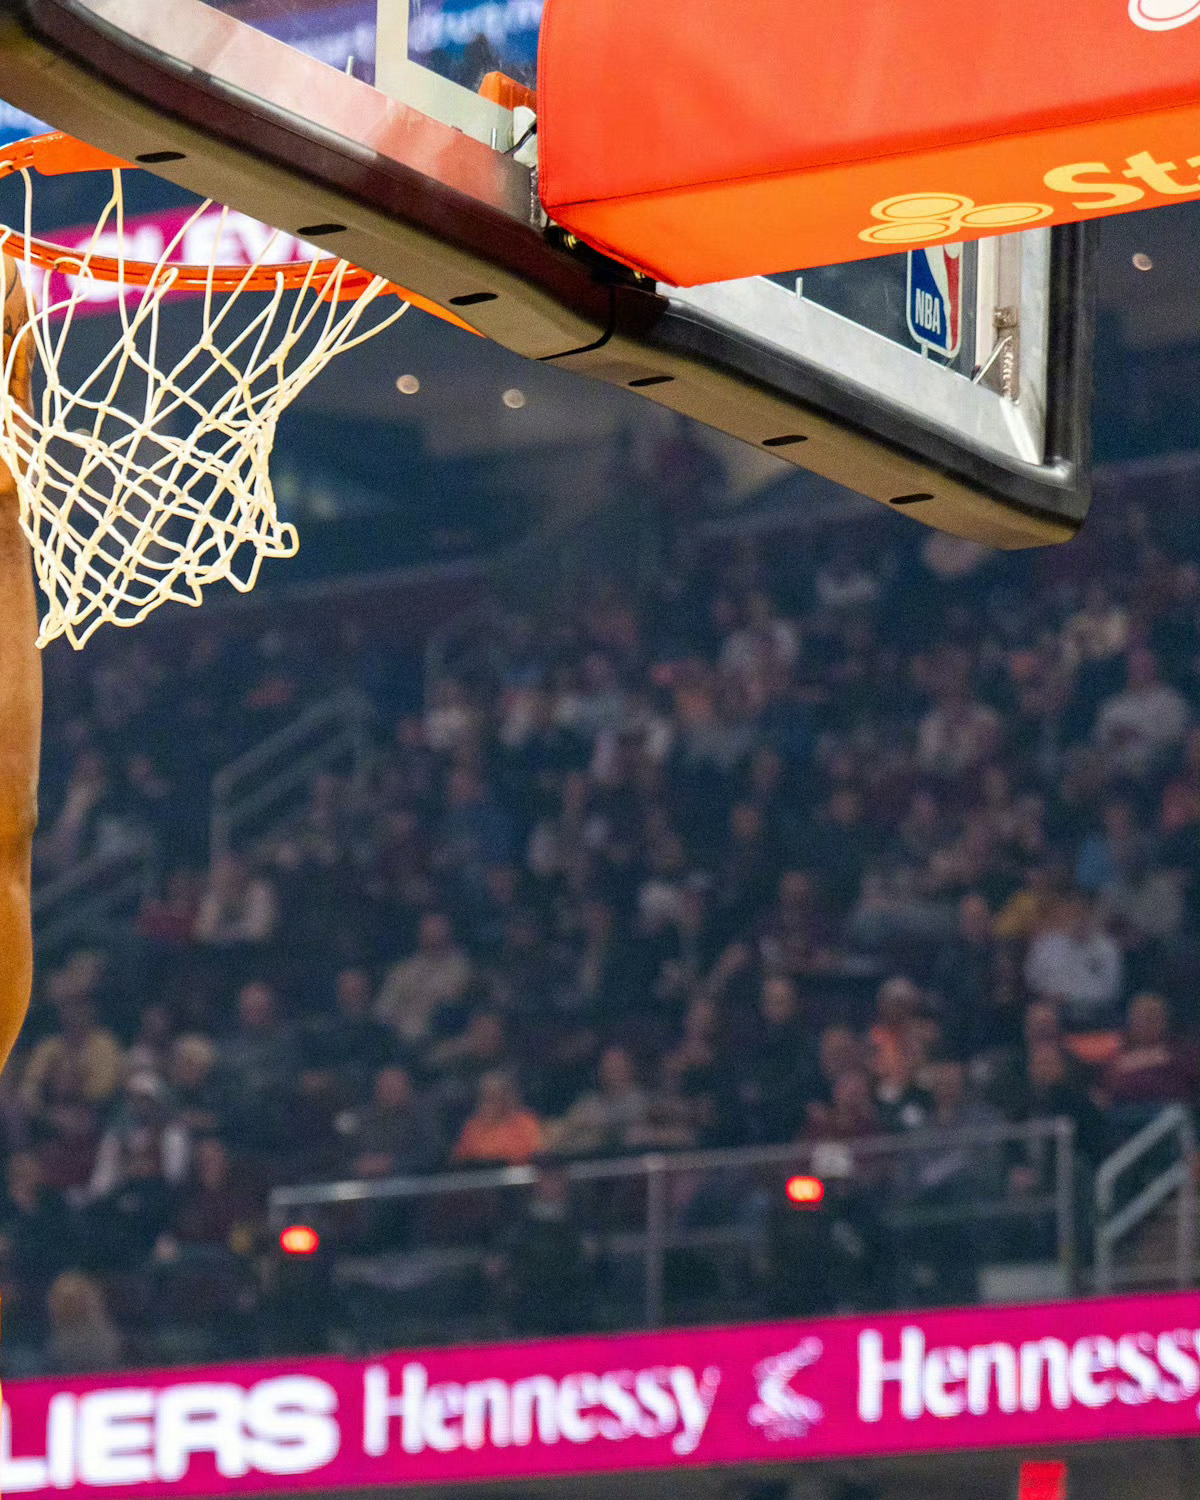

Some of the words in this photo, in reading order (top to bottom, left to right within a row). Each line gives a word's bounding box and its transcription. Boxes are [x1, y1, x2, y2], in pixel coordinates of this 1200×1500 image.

[1043, 150, 1200, 210] St
[914, 287, 941, 335] NBA
[363, 1361, 720, 1455] Hennessy
[857, 1325, 1200, 1422] Henness
